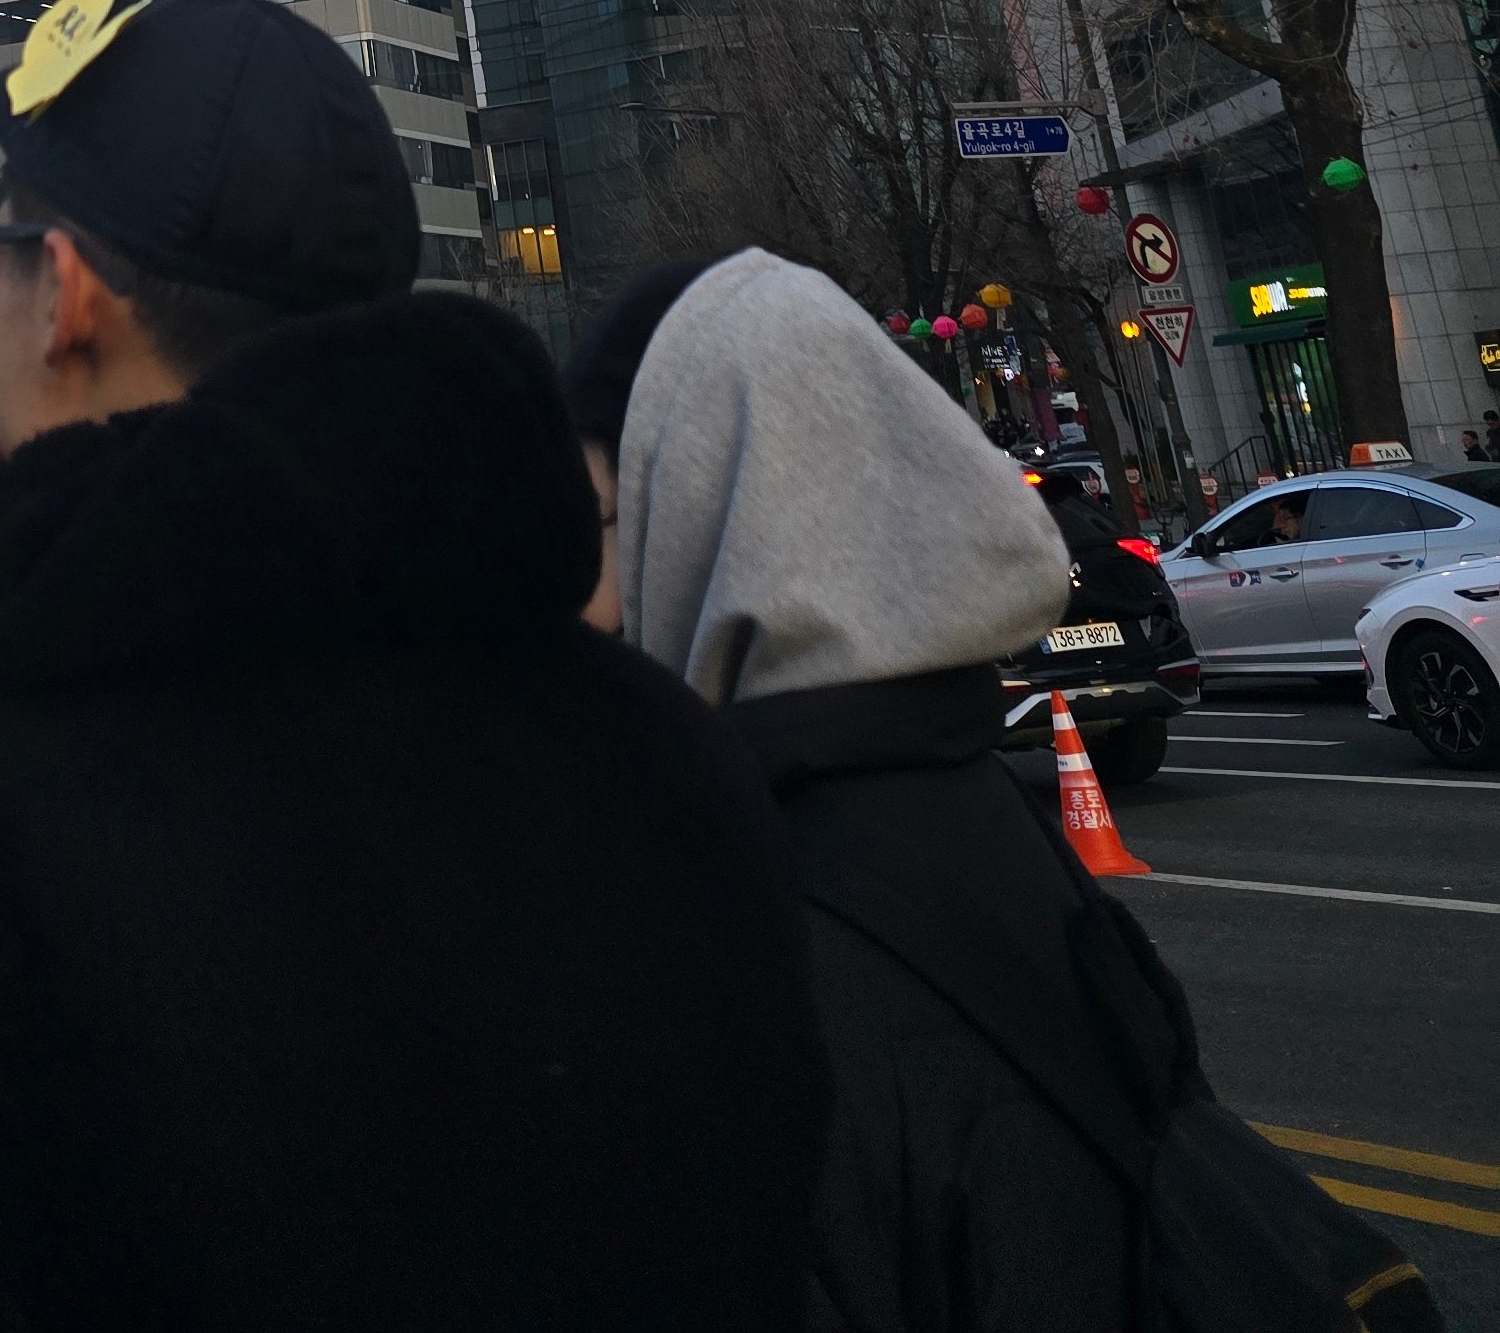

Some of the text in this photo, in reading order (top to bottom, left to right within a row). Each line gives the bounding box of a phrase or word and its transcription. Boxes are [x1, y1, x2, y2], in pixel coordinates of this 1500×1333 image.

[962, 120, 1026, 140] 율곡로4길
[964, 139, 1036, 155] Yulgok-ro 4-gil
[1155, 314, 1184, 330] 천천히
[1376, 447, 1407, 460] TAXI
[1051, 625, 1121, 649] 138구 8872
[1069, 789, 1102, 810] 종로
[1067, 809, 1113, 830] 경찰서
